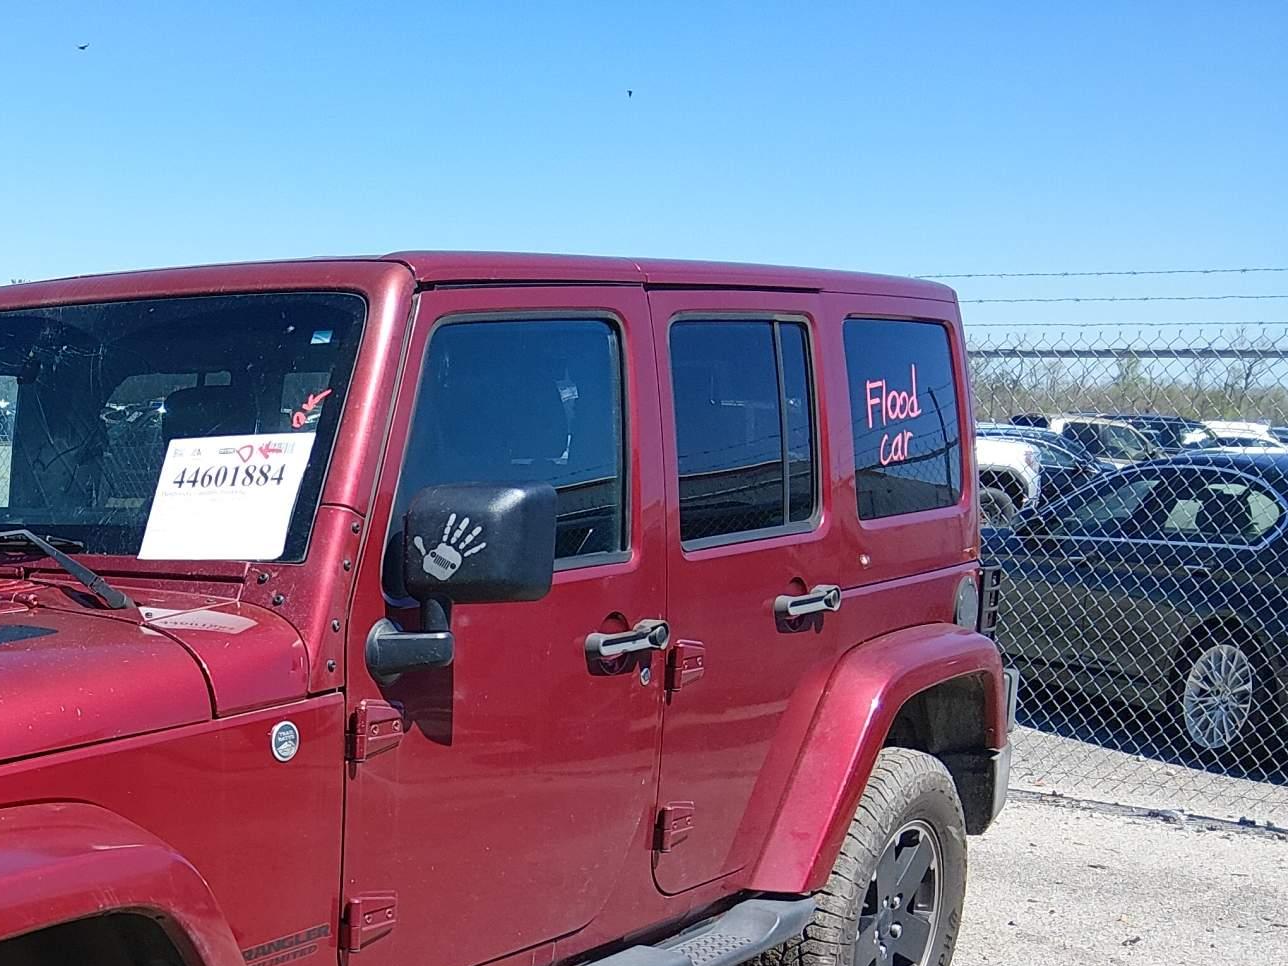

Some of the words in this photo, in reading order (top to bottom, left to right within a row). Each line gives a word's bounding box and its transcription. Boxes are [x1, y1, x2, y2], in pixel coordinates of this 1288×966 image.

[866, 363, 922, 429] Flood
[879, 429, 914, 466] car
[173, 463, 287, 489] 44601884
